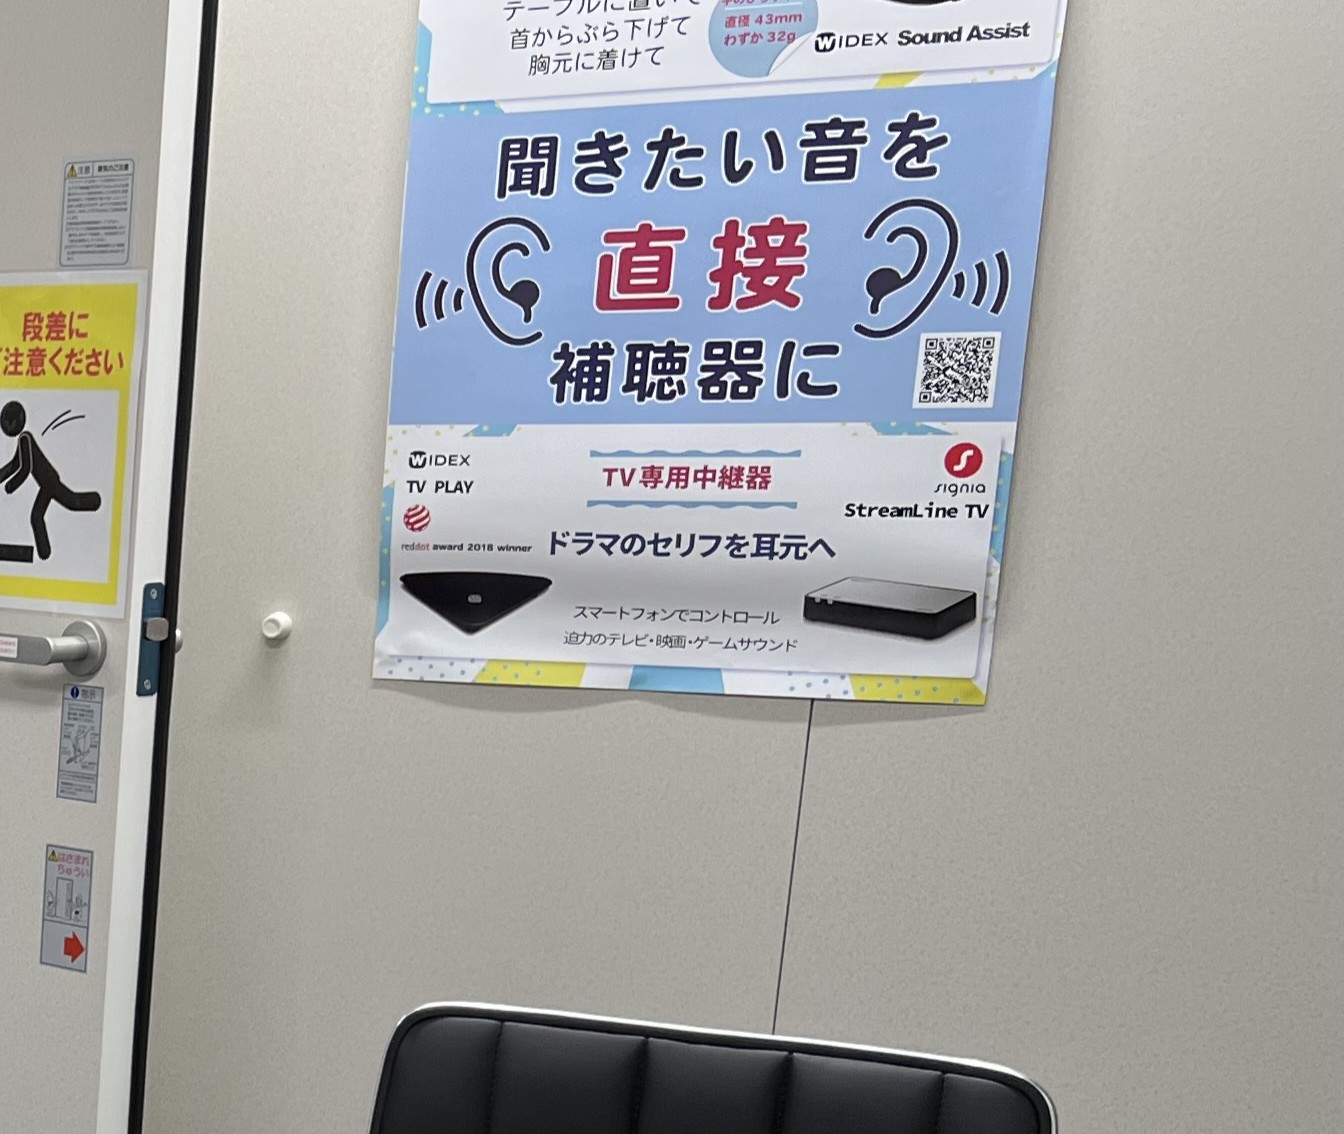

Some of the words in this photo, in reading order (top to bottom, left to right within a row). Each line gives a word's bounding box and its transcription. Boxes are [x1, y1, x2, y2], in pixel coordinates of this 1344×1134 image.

[724, 14, 751, 28] 直径
[755, 12, 802, 25] 43mm
[510, 15, 692, 50] 首からぶら下げて
[723, 32, 764, 46] わずか
[767, 31, 797, 44] 32g
[814, 32, 889, 53] WIDEX
[897, 29, 962, 47] Sound
[967, 22, 1031, 42] Assist
[527, 46, 666, 77] 胸元に着けて
[496, 111, 950, 200] 聞きたい音を
[593, 216, 812, 314] 直接
[22, 310, 90, 342] 段差に
[548, 339, 843, 405] 補聴器に
[408, 450, 471, 469] WIDEX
[406, 480, 427, 494] TV
[434, 480, 474, 494] PLAY
[601, 465, 773, 491] TV専用中継器
[933, 483, 986, 498] signia
[844, 501, 959, 519] StreamLine
[965, 504, 990, 519] TV
[432, 543, 464, 552] award
[467, 543, 494, 552] 2018
[497, 544, 532, 553] winner
[547, 530, 838, 560] ドラマのセリフを耳元へ
[573, 605, 780, 625] スマートフォンでコントロール
[563, 631, 799, 653] 迫力のテレビ・映画・ゲームサウンド
